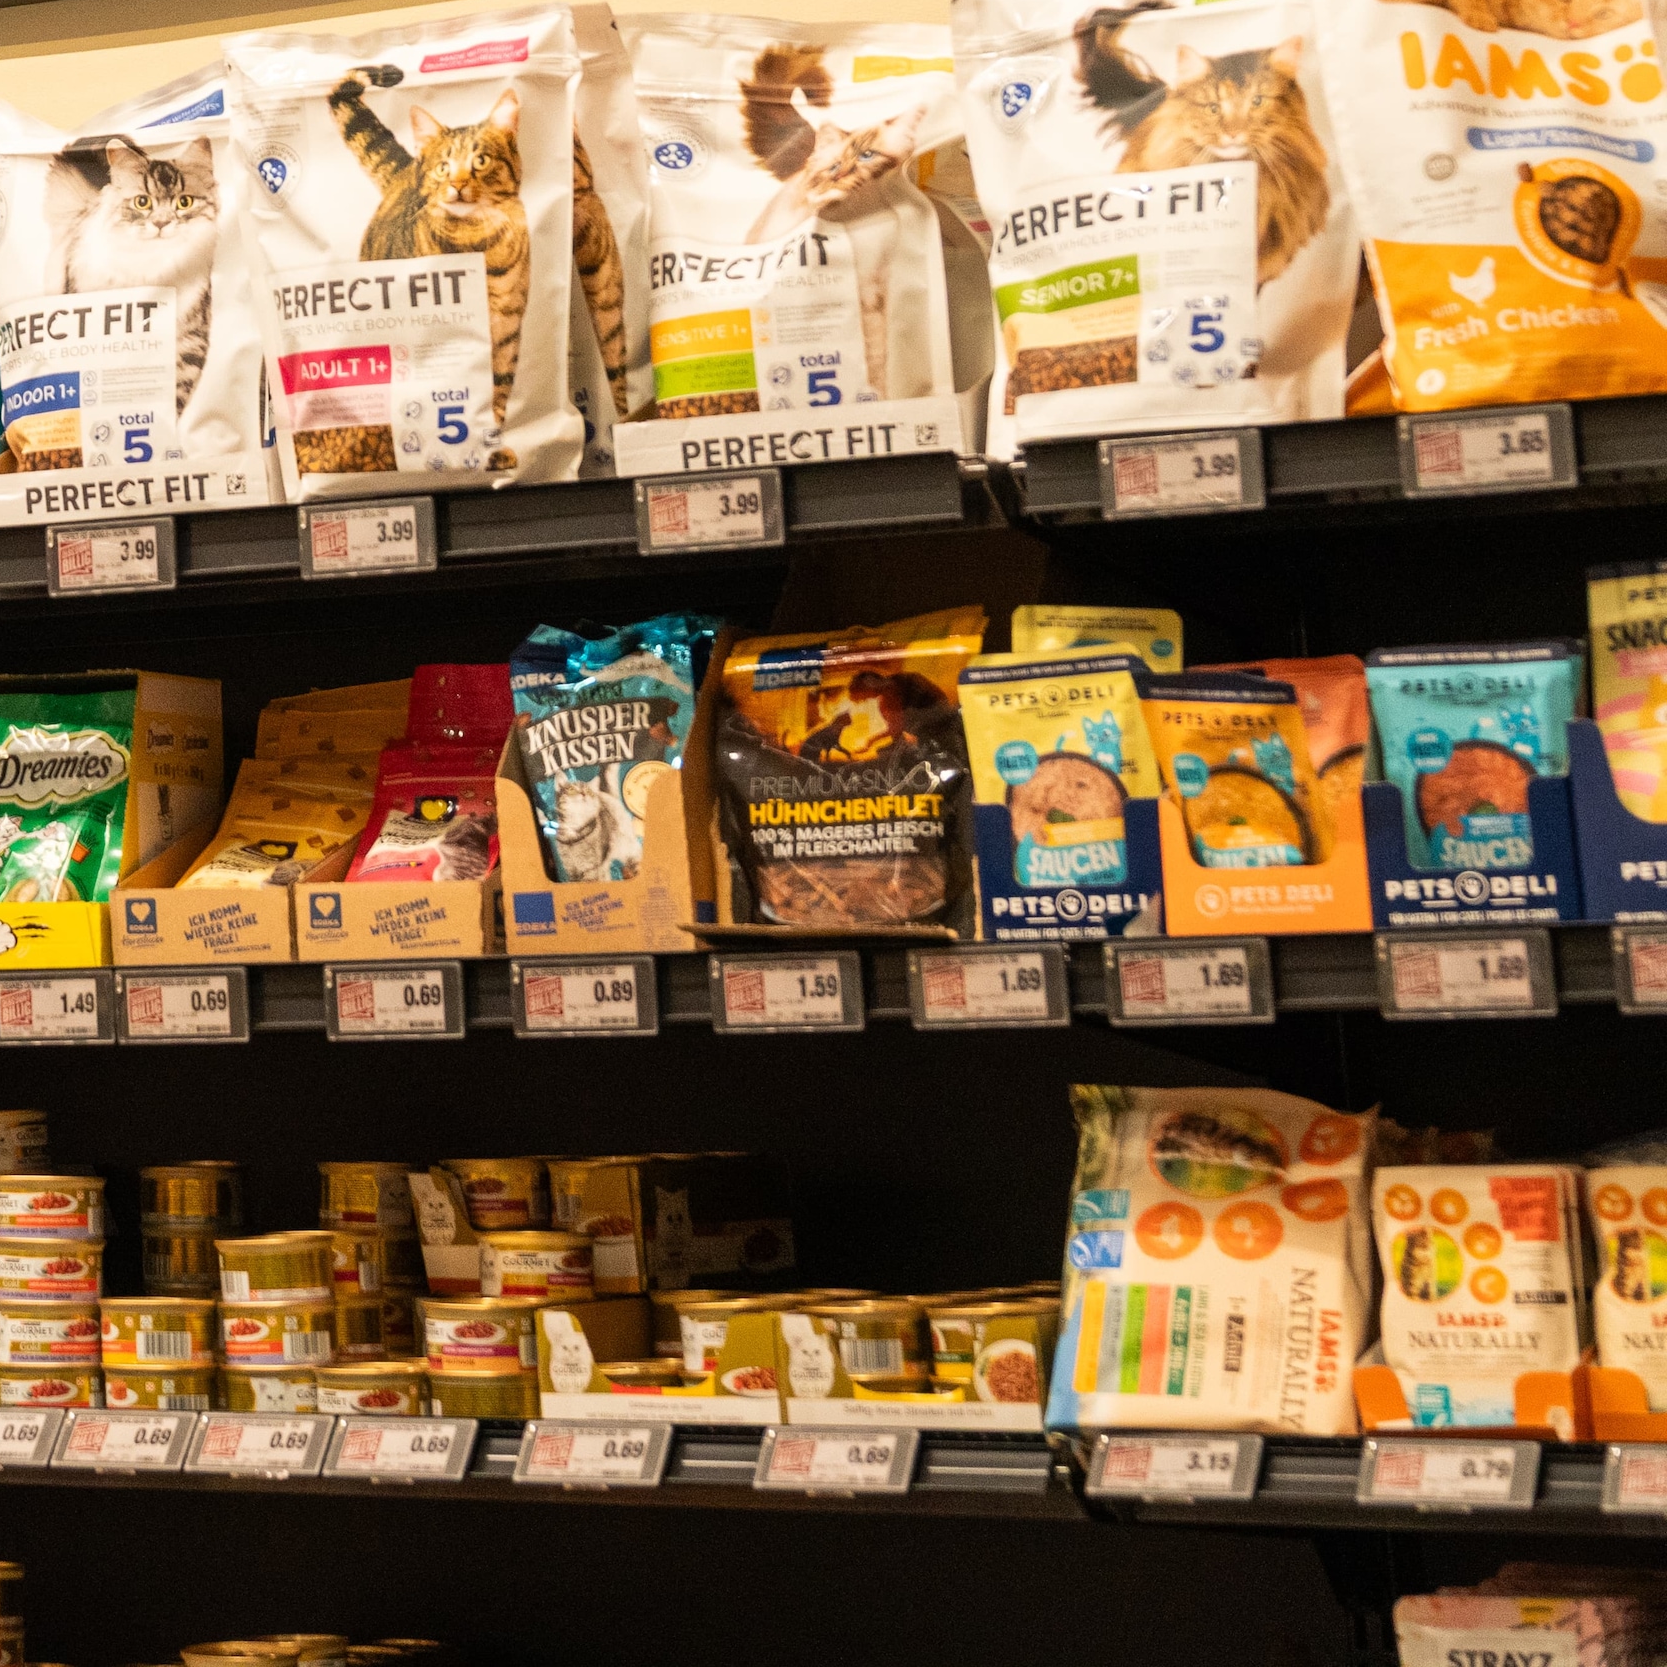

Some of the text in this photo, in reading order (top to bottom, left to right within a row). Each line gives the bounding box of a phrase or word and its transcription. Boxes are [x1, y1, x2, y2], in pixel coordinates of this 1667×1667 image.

[1399, 31, 1611, 106] IAMS
[272, 270, 467, 321] PERFECT FIT
[1414, 304, 1620, 351] Fresh Chicken
[799, 350, 841, 367] total
[431, 387, 470, 404] total
[806, 371, 842, 407] 5
[119, 410, 154, 427] total
[436, 407, 469, 445] 5
[123, 430, 154, 464] 5
[682, 424, 897, 469] PERFECT FIT
[25, 472, 210, 515] PERFECT FIT
[720, 493, 759, 517] 3.99
[526, 702, 651, 755] KNUSPER
[540, 732, 636, 777] KISSEN
[749, 793, 944, 826] HÜHNCHENFILET
[1026, 845, 1120, 879] SAUCEN
[1385, 875, 1557, 900] PETS DELI
[60, 991, 94, 1013] 1.49
[594, 980, 632, 1002] 0.89
[797, 974, 837, 998] 1.59
[1409, 1331, 1540, 1351] NATURALLY
